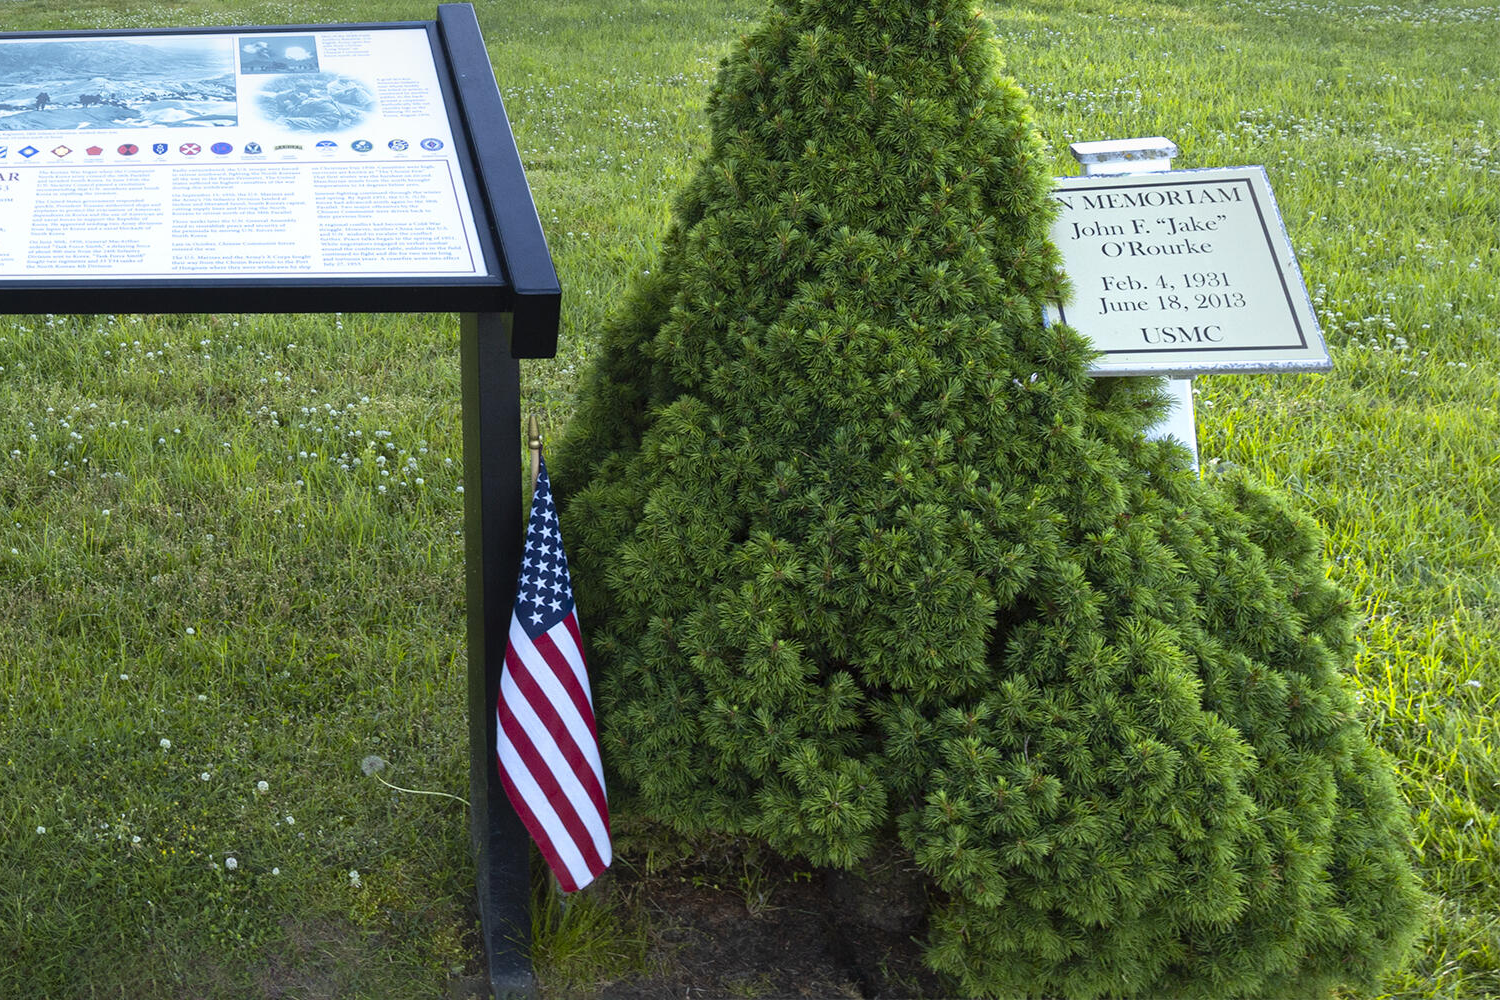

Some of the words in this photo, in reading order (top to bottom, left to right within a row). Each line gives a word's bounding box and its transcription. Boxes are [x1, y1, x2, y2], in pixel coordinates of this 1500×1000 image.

[1056, 196, 1073, 210] N
[1082, 187, 1241, 210] MEMORIAM
[1071, 221, 1124, 240] John
[1131, 219, 1150, 234] F.
[1156, 215, 1227, 235] “Jake”
[1101, 238, 1213, 257] O'Rourke
[1100, 275, 1148, 291] Feb.
[1156, 274, 1175, 291] 4,
[1184, 272, 1230, 288] 1931
[1099, 297, 1149, 315] June
[1158, 295, 1189, 312] 18,
[1195, 292, 1246, 309] 2013
[1139, 325, 1224, 344] USMC
